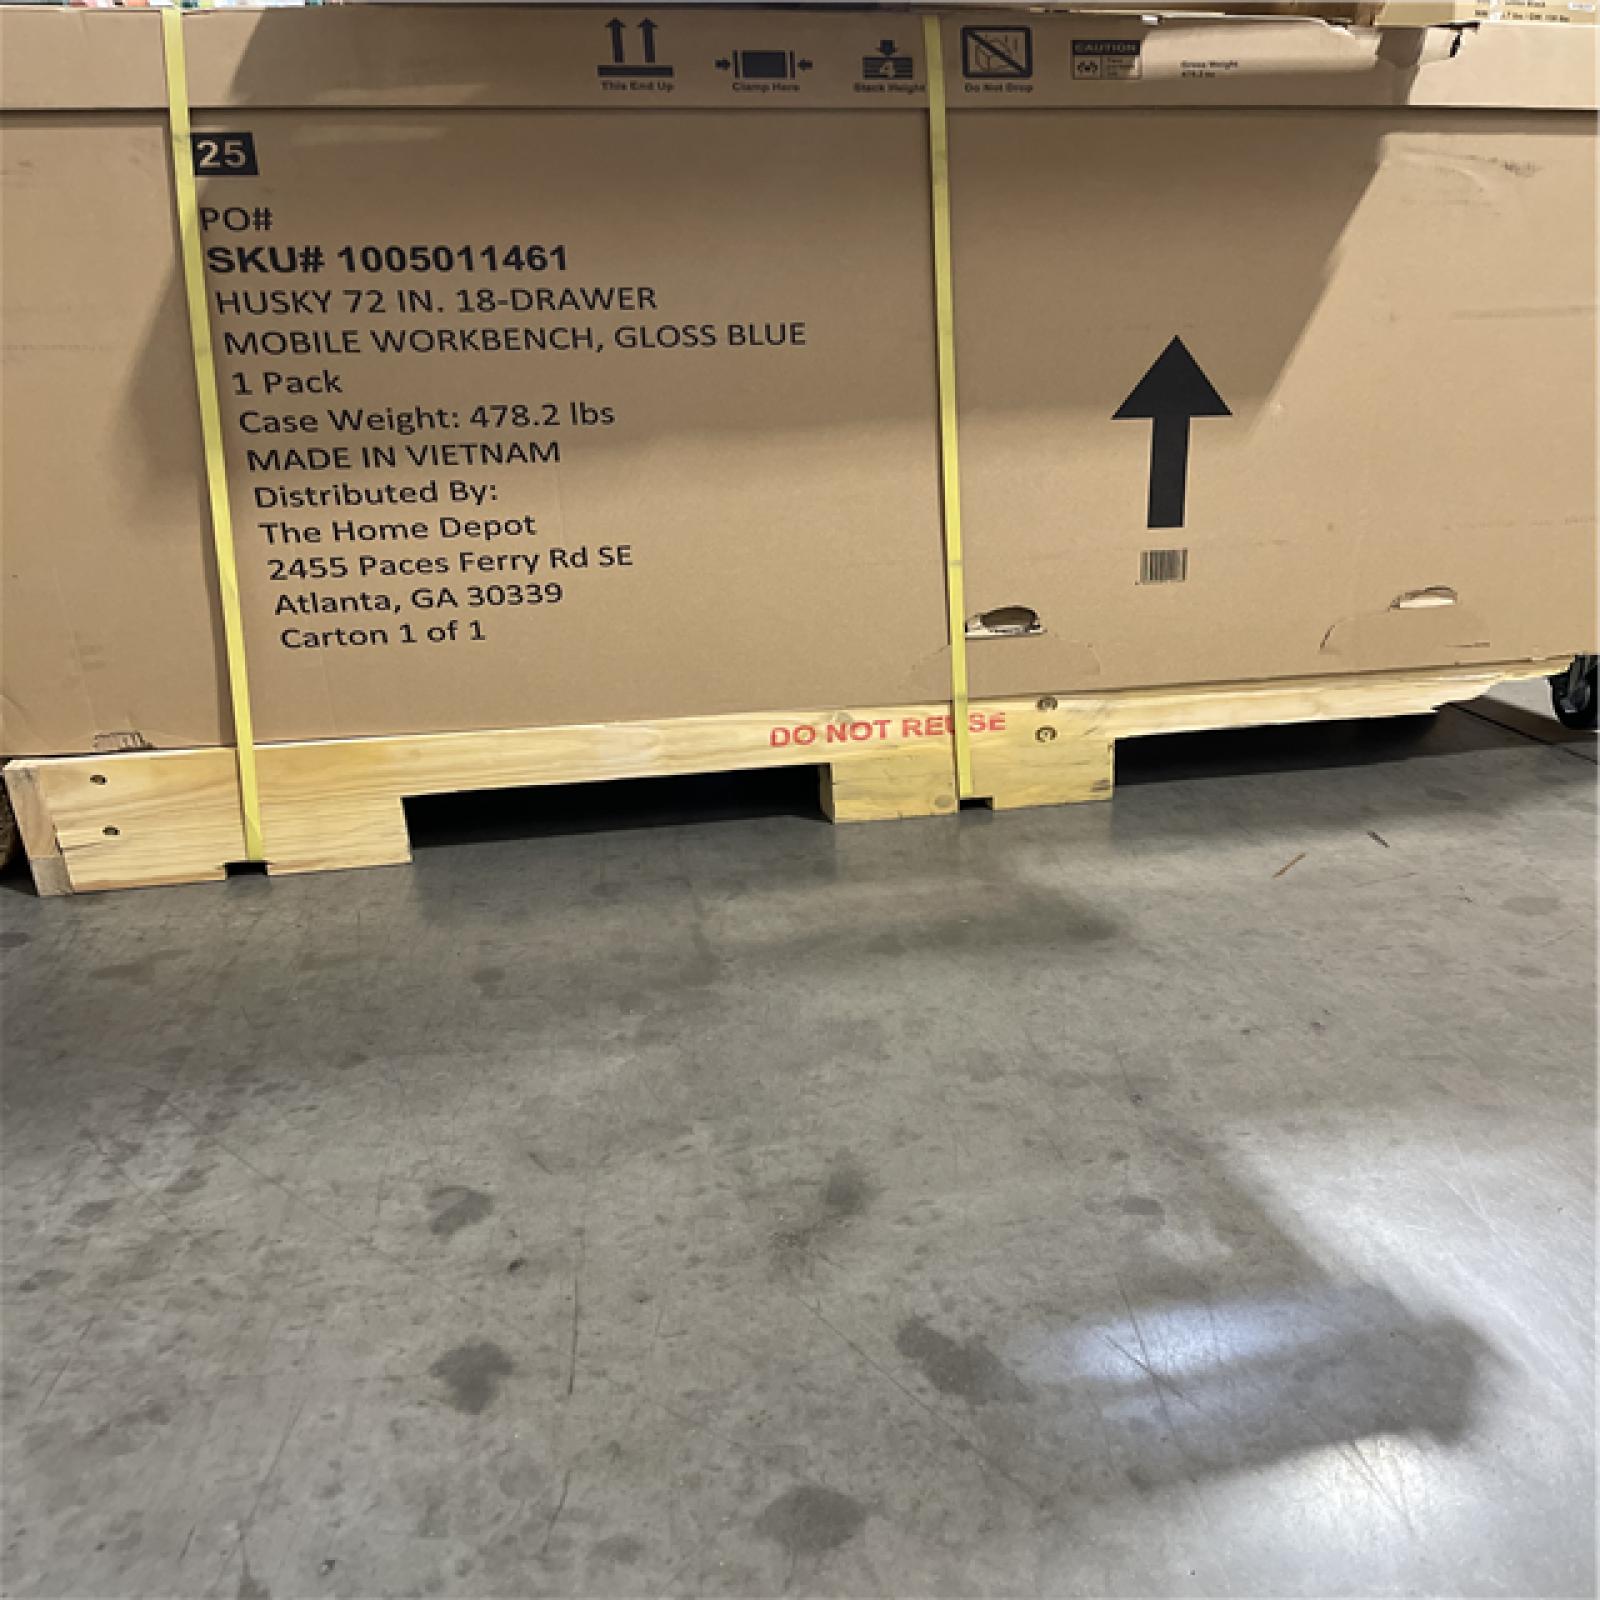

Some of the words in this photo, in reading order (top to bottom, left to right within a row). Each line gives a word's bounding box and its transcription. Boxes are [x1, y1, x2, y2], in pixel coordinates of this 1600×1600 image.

[1075, 43, 1138, 53] CAUTION
[879, 61, 896, 79] 4
[602, 80, 627, 92] This
[629, 80, 654, 91] End
[656, 80, 674, 93] Up
[732, 81, 770, 94] Clamp
[772, 81, 801, 92] Here
[854, 82, 884, 93] Stack
[887, 83, 926, 95] Height
[964, 83, 981, 93] Do
[983, 83, 1003, 93] Not
[1006, 83, 1033, 95] Drop
[197, 140, 246, 168] 25
[200, 207, 272, 230] PO#
[207, 245, 326, 273] SKU#
[337, 244, 567, 273] 1005011461
[215, 289, 332, 315] HUSKY
[342, 289, 386, 313] 72
[397, 289, 444, 313] IN.
[456, 286, 657, 314] 18-DRAWER
[224, 330, 361, 355] MOBILE
[370, 326, 604, 353] WORKBENCH,
[614, 324, 717, 348] GLOSS
[727, 322, 807, 346] BLUE
[232, 372, 253, 395] 1
[263, 370, 343, 395] Pack
[239, 410, 319, 433] Case
[328, 406, 460, 435] Weight:
[469, 403, 560, 430] 478.2
[570, 401, 616, 426] lbs
[247, 447, 352, 471] MADE
[361, 445, 397, 469] IN
[405, 440, 561, 468] VIETNAM
[254, 480, 438, 508] Distributed
[449, 480, 498, 505] By:
[258, 521, 322, 545] The
[332, 519, 429, 543] Home
[439, 515, 538, 542] Depot
[267, 556, 349, 580] 2455
[359, 554, 450, 577] Paces
[459, 552, 541, 575] Ferry
[549, 545, 589, 569] Rd
[598, 544, 634, 567] SE
[275, 592, 402, 616] Atlanta,
[410, 586, 458, 609] GA
[467, 582, 563, 608] 30339
[280, 627, 389, 649] Carton
[400, 622, 417, 643] 1
[426, 620, 458, 643] of
[469, 619, 487, 641] 1
[769, 726, 816, 747] DO
[826, 719, 891, 743] NOT
